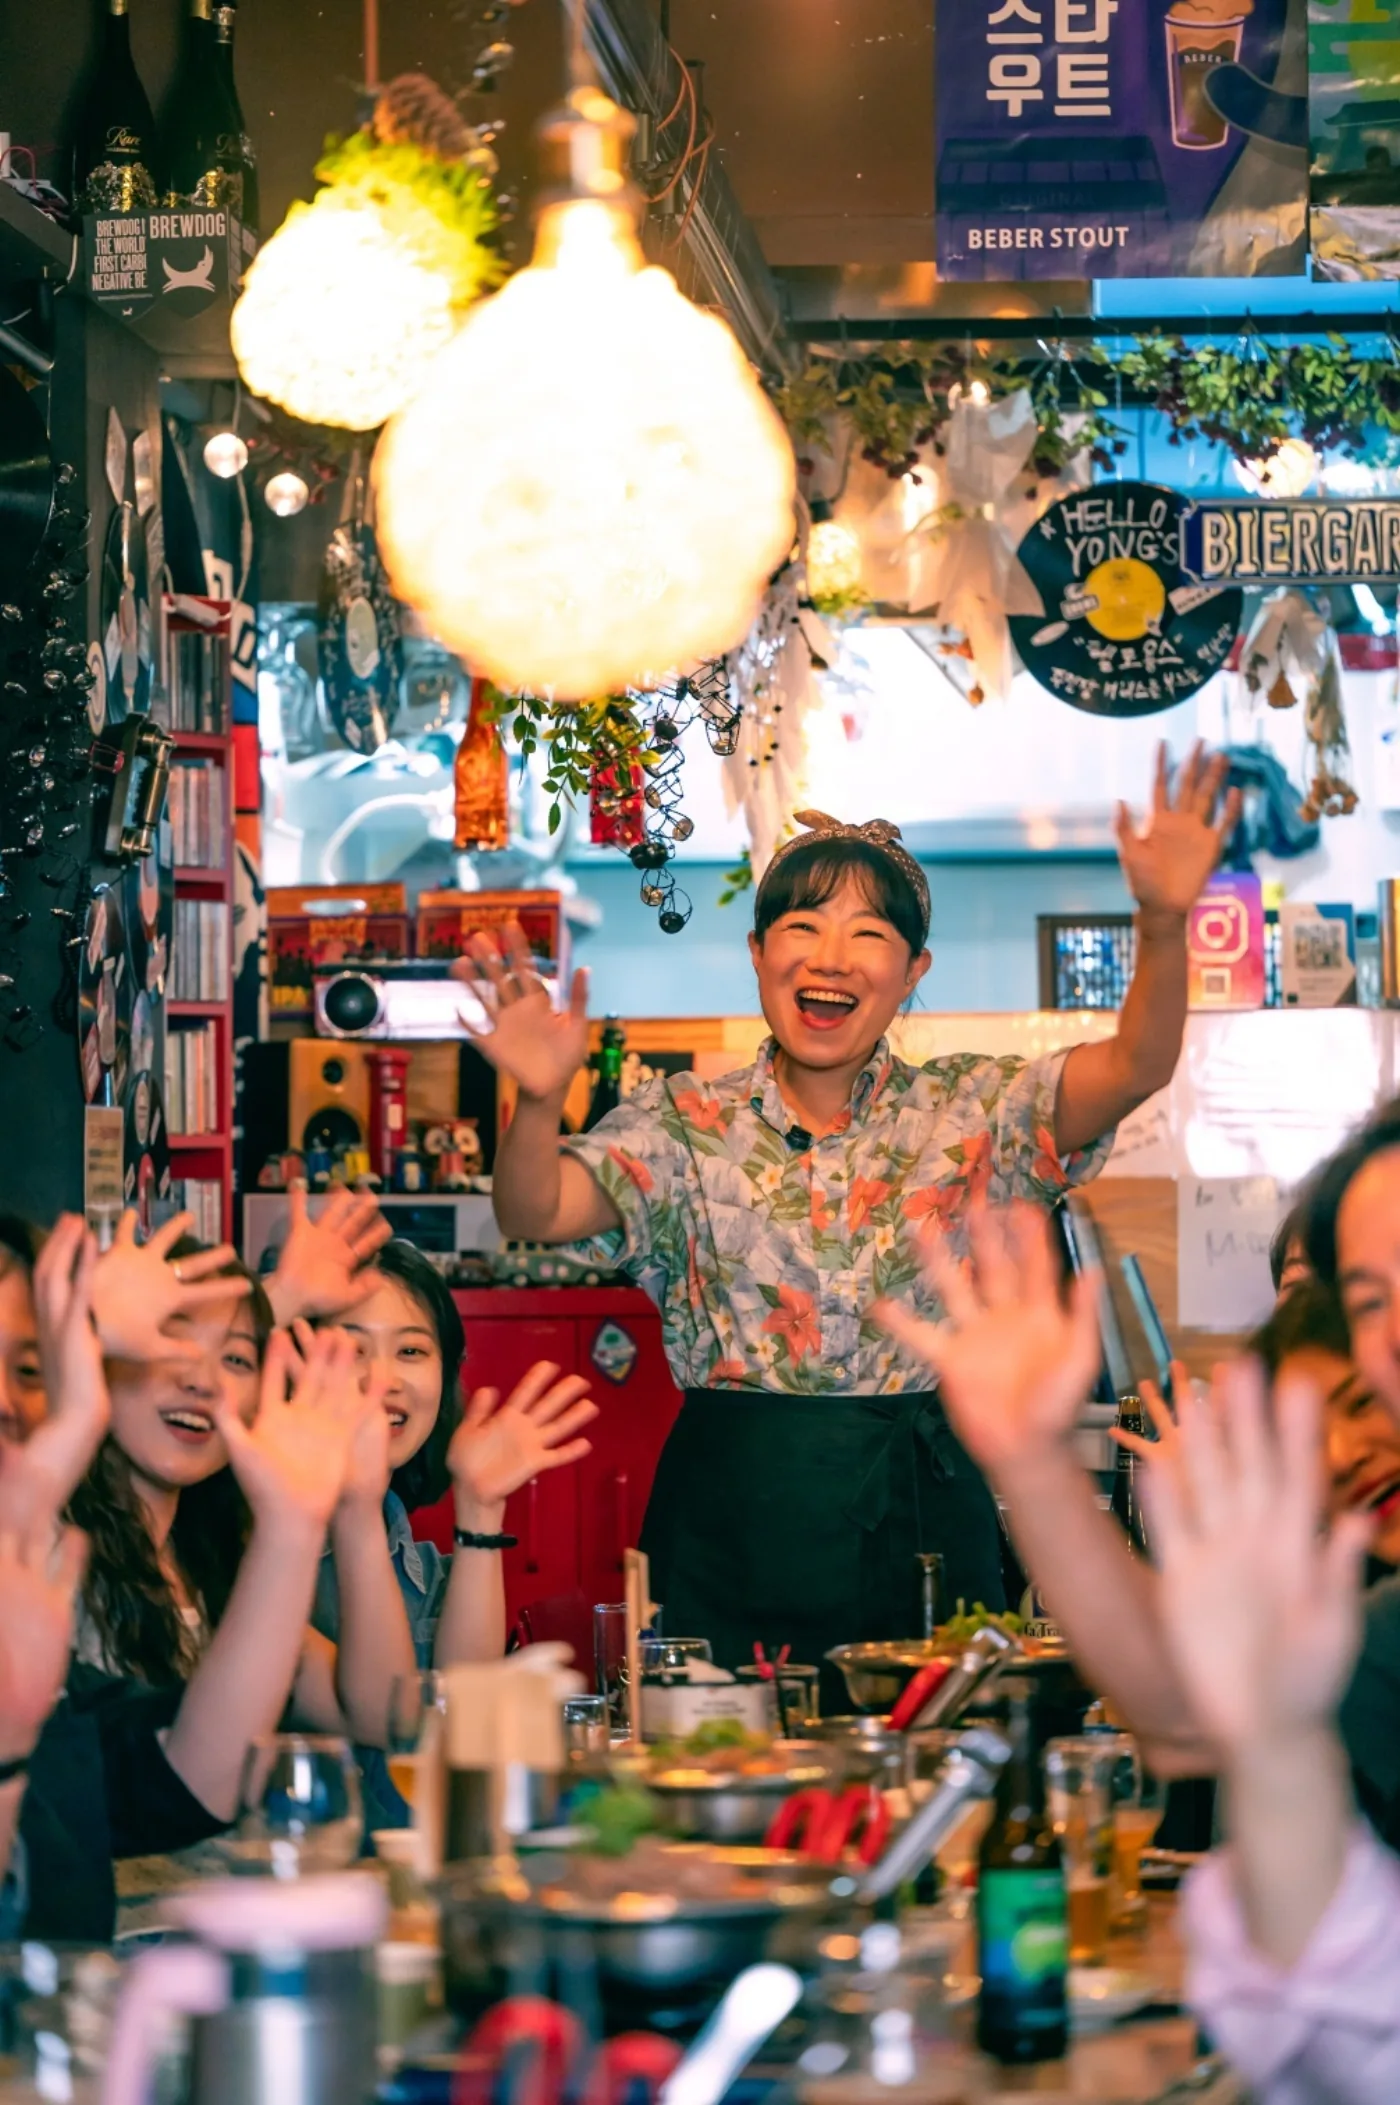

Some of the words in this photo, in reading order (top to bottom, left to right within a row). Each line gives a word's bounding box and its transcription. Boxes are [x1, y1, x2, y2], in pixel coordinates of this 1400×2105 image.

[986, 53, 1112, 118] 우트
[97, 218, 141, 238] BREWDOG
[150, 212, 227, 240] BREWDOG
[968, 228, 1044, 250] BEBER
[1049, 226, 1130, 248] STOUT
[95, 238, 114, 255] THE
[94, 255, 119, 273] FIRST
[92, 273, 134, 291] NEGATIVE
[1060, 498, 1168, 535] HELLO
[1064, 529, 1179, 577] YONG'S
